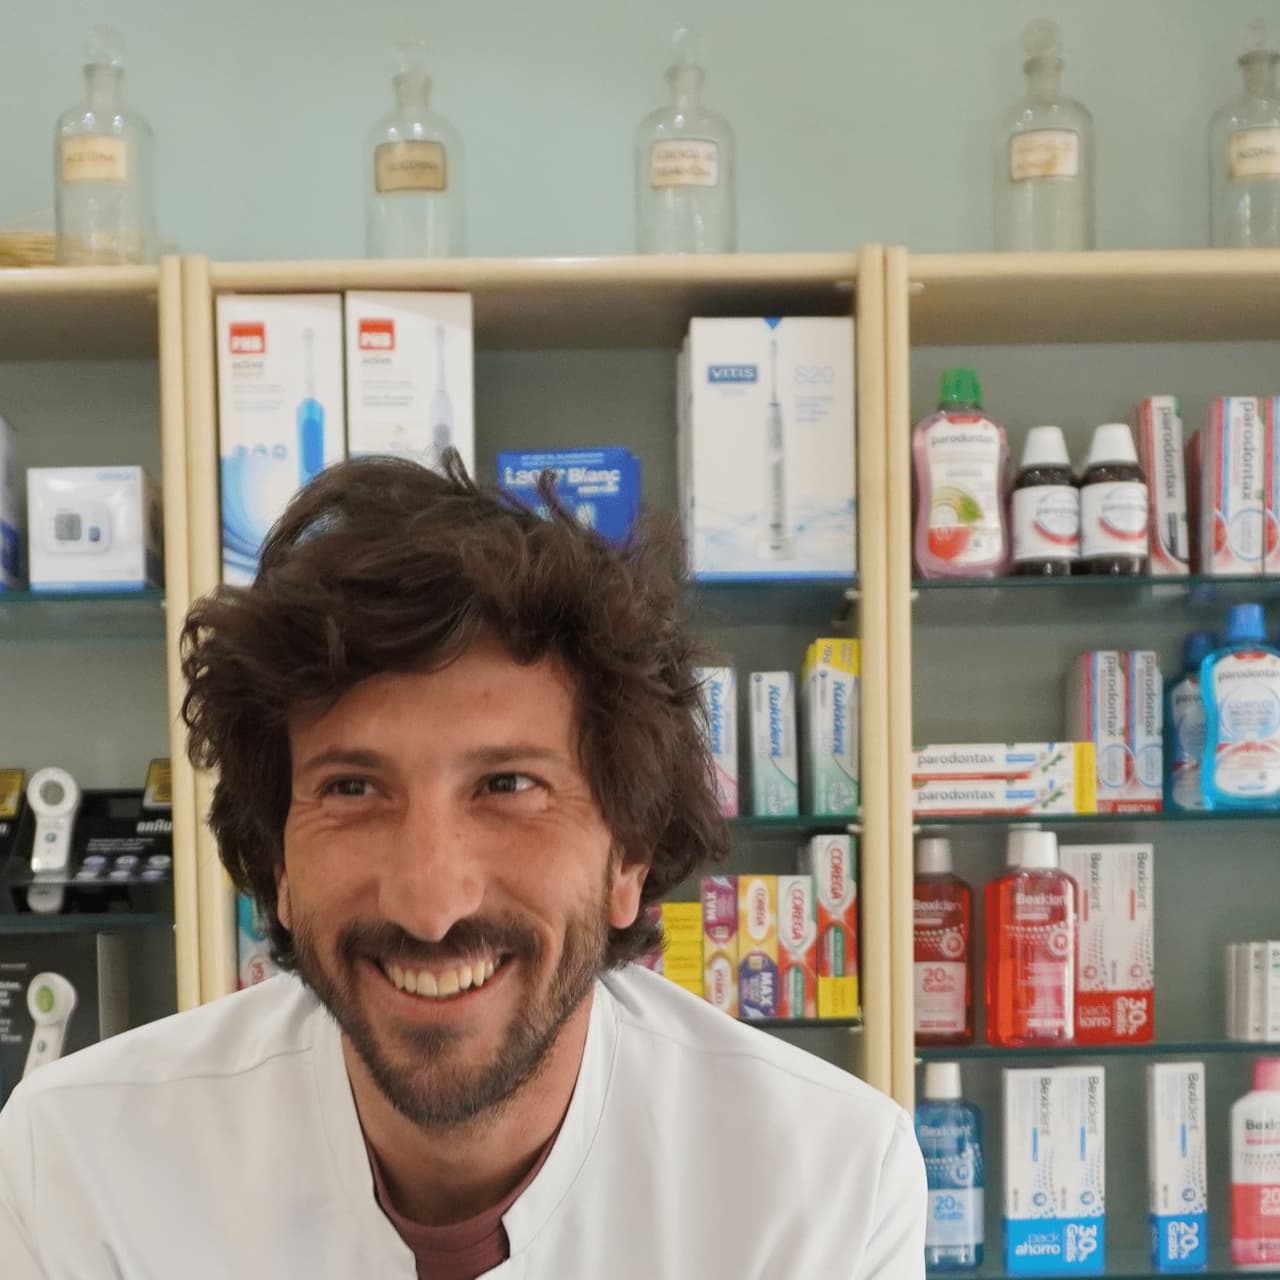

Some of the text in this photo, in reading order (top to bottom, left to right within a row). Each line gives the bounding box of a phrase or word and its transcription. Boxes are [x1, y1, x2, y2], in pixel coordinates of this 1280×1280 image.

[230, 337, 264, 352] PHB
[360, 332, 393, 348] PHB
[711, 368, 755, 379] VITIS
[930, 432, 996, 448] parodontax
[1159, 406, 1177, 499] parodontax
[1240, 400, 1255, 501] parodontax
[1218, 667, 1280, 682] parodontax
[1104, 654, 1116, 738] parodontax
[1144, 654, 1155, 737] parodontax
[768, 684, 784, 759] Kukident
[831, 679, 847, 756] Kukident
[918, 752, 996, 766] parodontax
[918, 788, 996, 801] parodontax
[136, 819, 173, 833] BRAU
[828, 847, 843, 901] COREGA
[704, 889, 718, 921] MAX
[790, 888, 805, 942] COREGA
[759, 971, 773, 1007] MAX
[1039, 1076, 1052, 1137] Bexident
[1087, 1076, 1100, 1136] Bexident
[1015, 1242, 1061, 1257] ahorro
